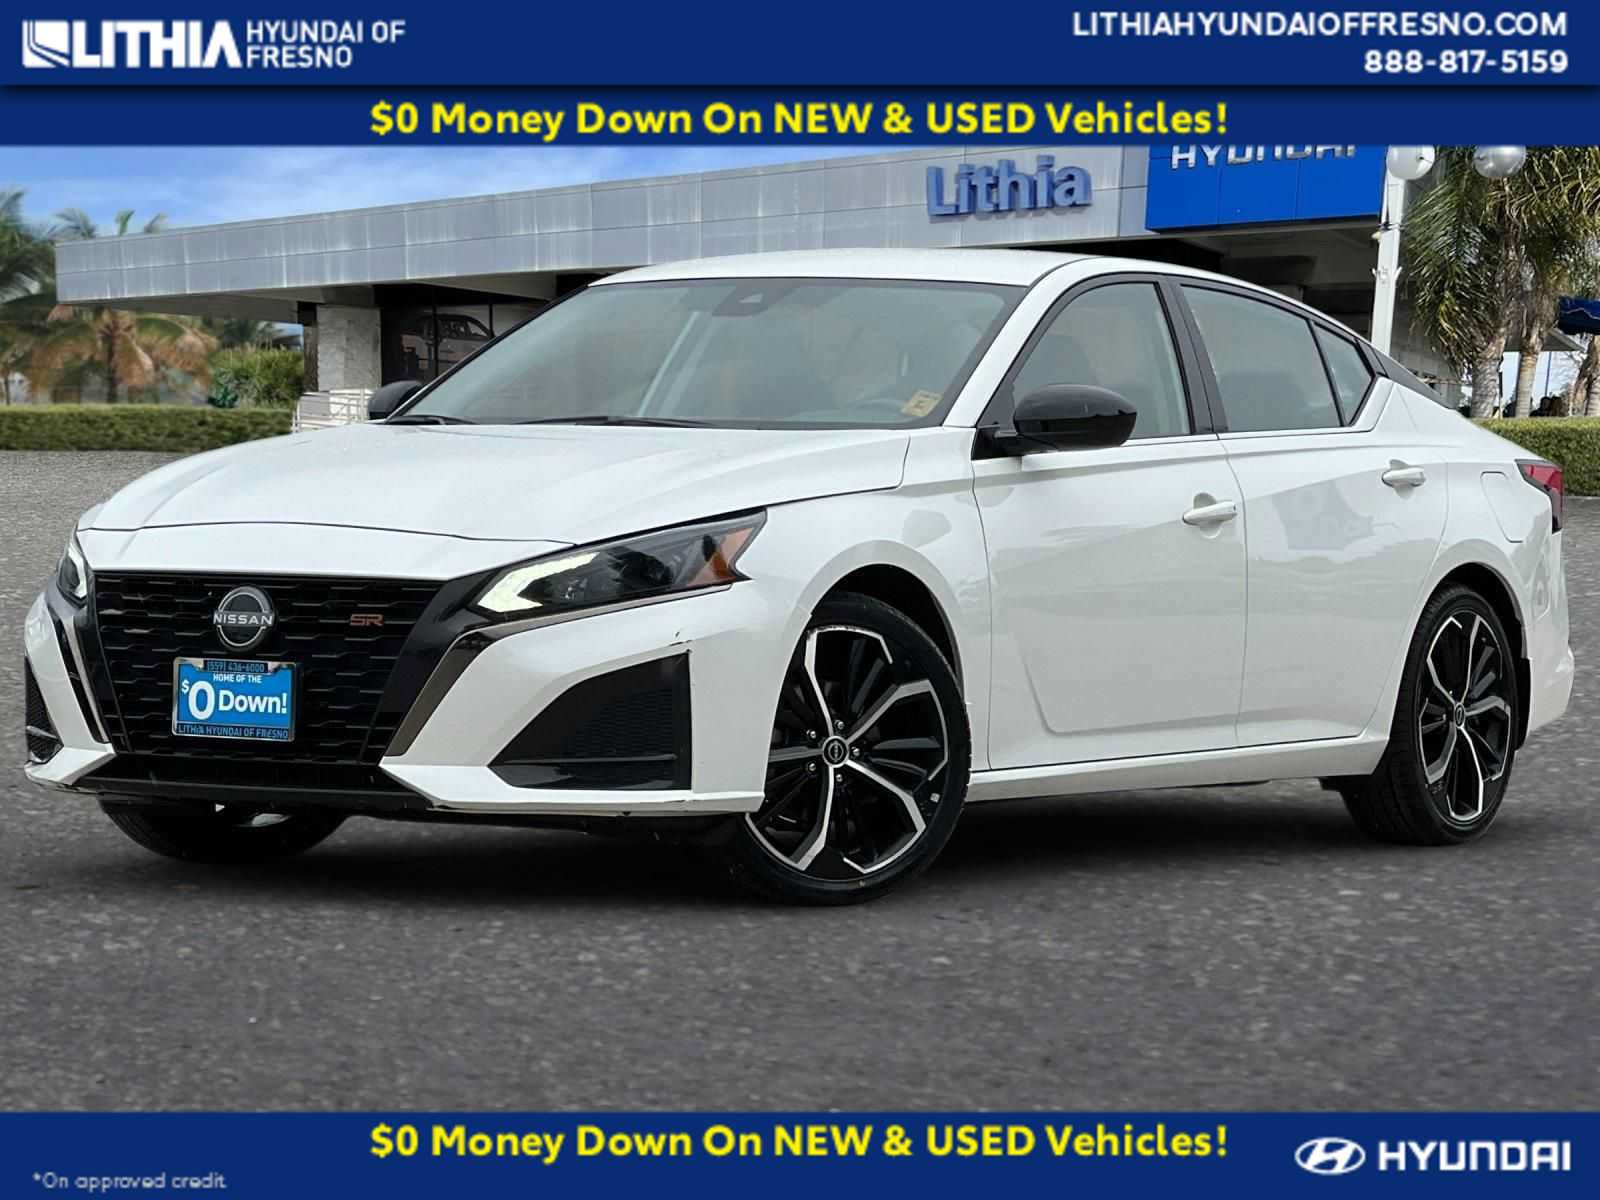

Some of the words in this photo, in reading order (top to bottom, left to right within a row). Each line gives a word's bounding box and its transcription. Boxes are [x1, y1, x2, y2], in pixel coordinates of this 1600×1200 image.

[927, 155, 1092, 216] Lithia
[213, 613, 273, 625] NISSAN
[350, 613, 384, 626] SR
[213, 673, 233, 682] HOME
[236, 674, 245, 683] OF
[248, 675, 262, 684] THE
[218, 690, 288, 714] Down!
[206, 726, 242, 737] HYUNDAI
[244, 728, 254, 738] OF
[256, 729, 288, 739] FRESNO
